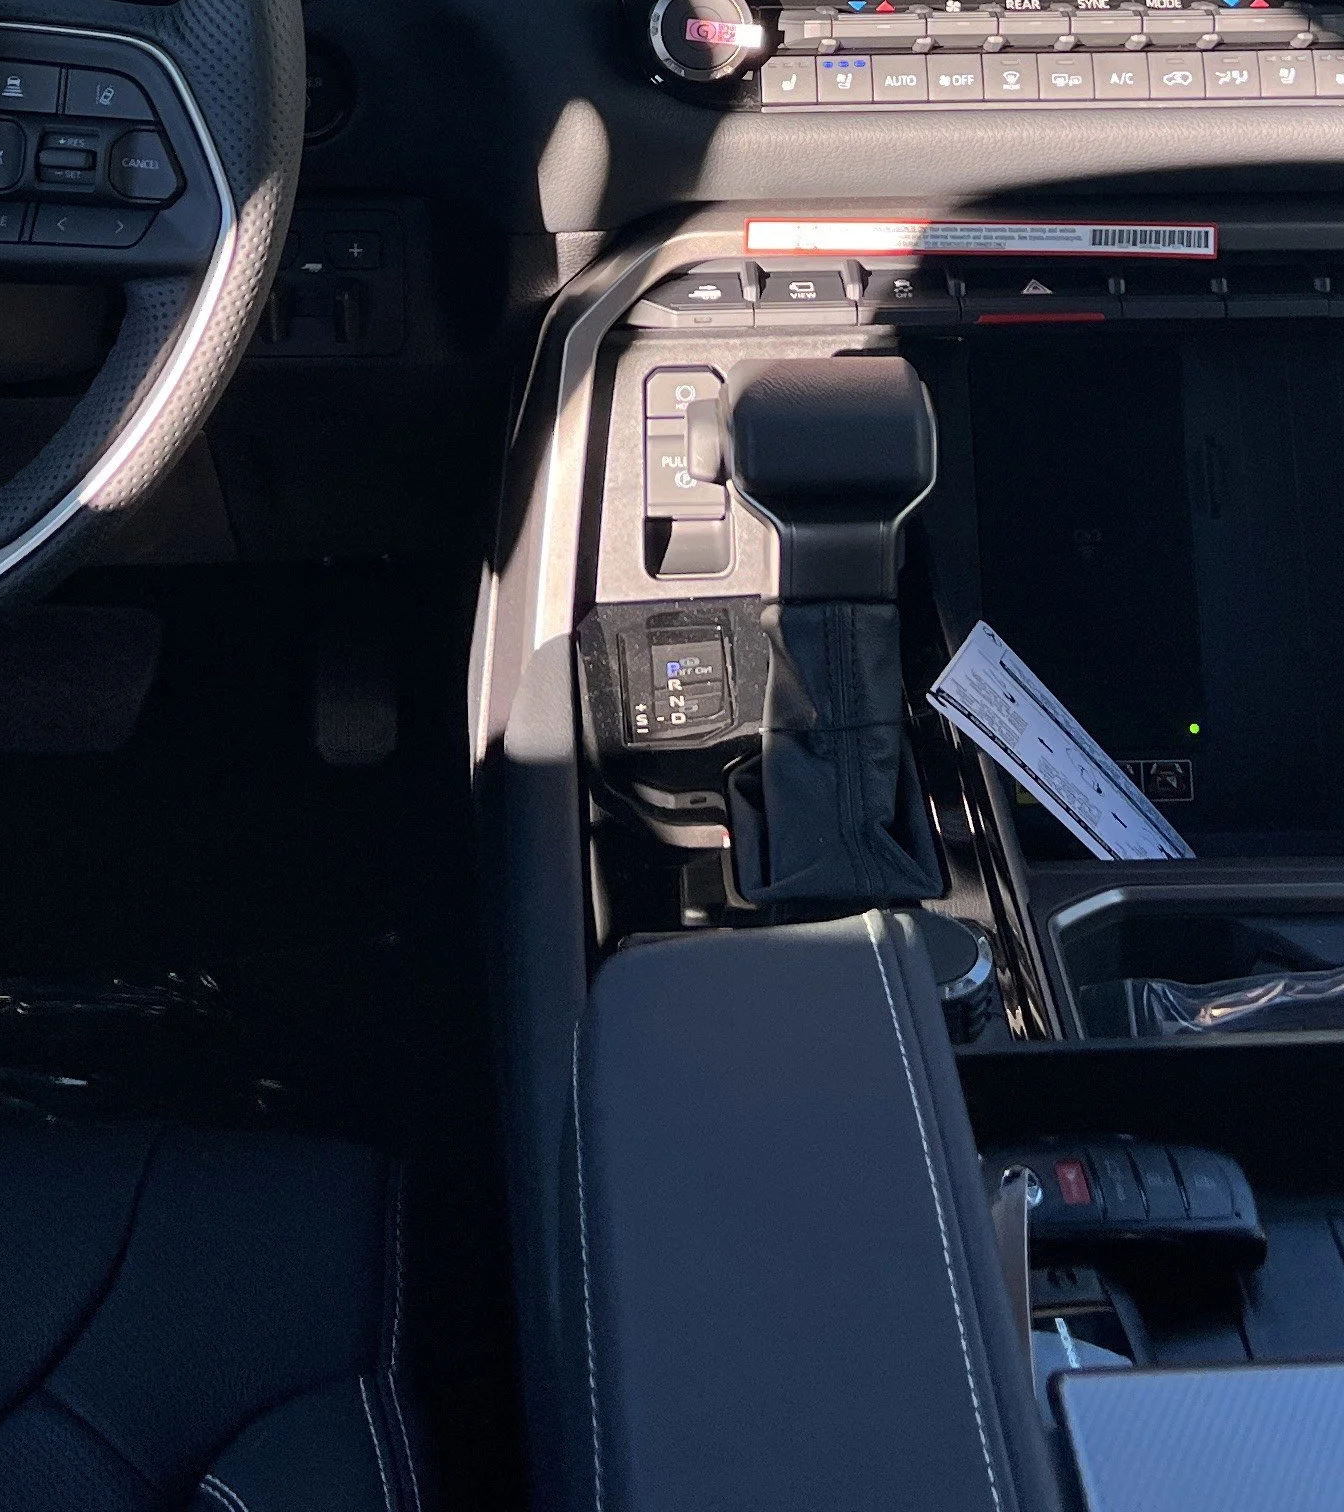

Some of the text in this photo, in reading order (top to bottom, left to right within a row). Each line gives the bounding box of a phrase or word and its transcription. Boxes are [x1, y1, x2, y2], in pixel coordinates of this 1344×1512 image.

[884, 75, 917, 87] AUTO
[952, 74, 975, 86] OFF
[1109, 72, 1134, 86] A/C
[121, 157, 159, 170] CANCEL
[790, 291, 817, 299] VIEW
[666, 661, 681, 677] P
[668, 678, 683, 691] R
[669, 695, 685, 707] N
[636, 714, 648, 726] S
[671, 712, 686, 725] D
